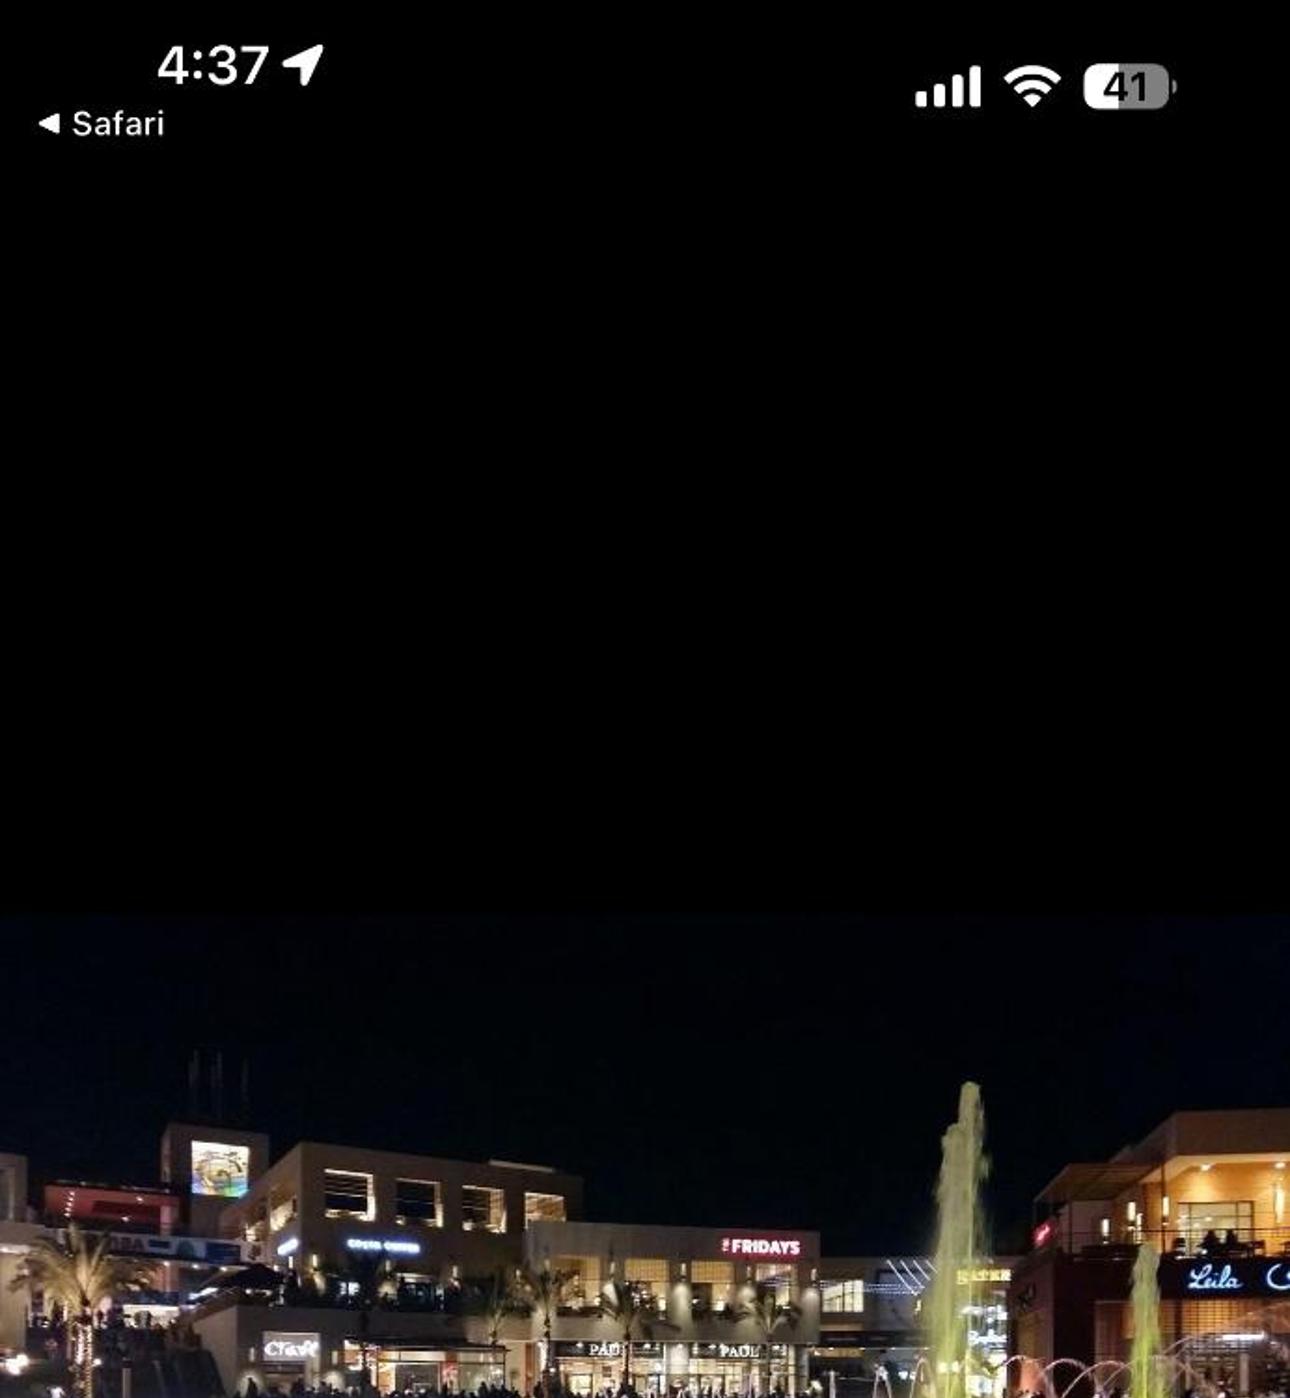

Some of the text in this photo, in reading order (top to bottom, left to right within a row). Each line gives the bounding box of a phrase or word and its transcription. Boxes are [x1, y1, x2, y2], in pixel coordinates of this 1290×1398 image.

[731, 1238, 801, 1256] FRIDAYS
[1187, 1263, 1243, 1289] Leila
[719, 1343, 760, 1358] PAUL
